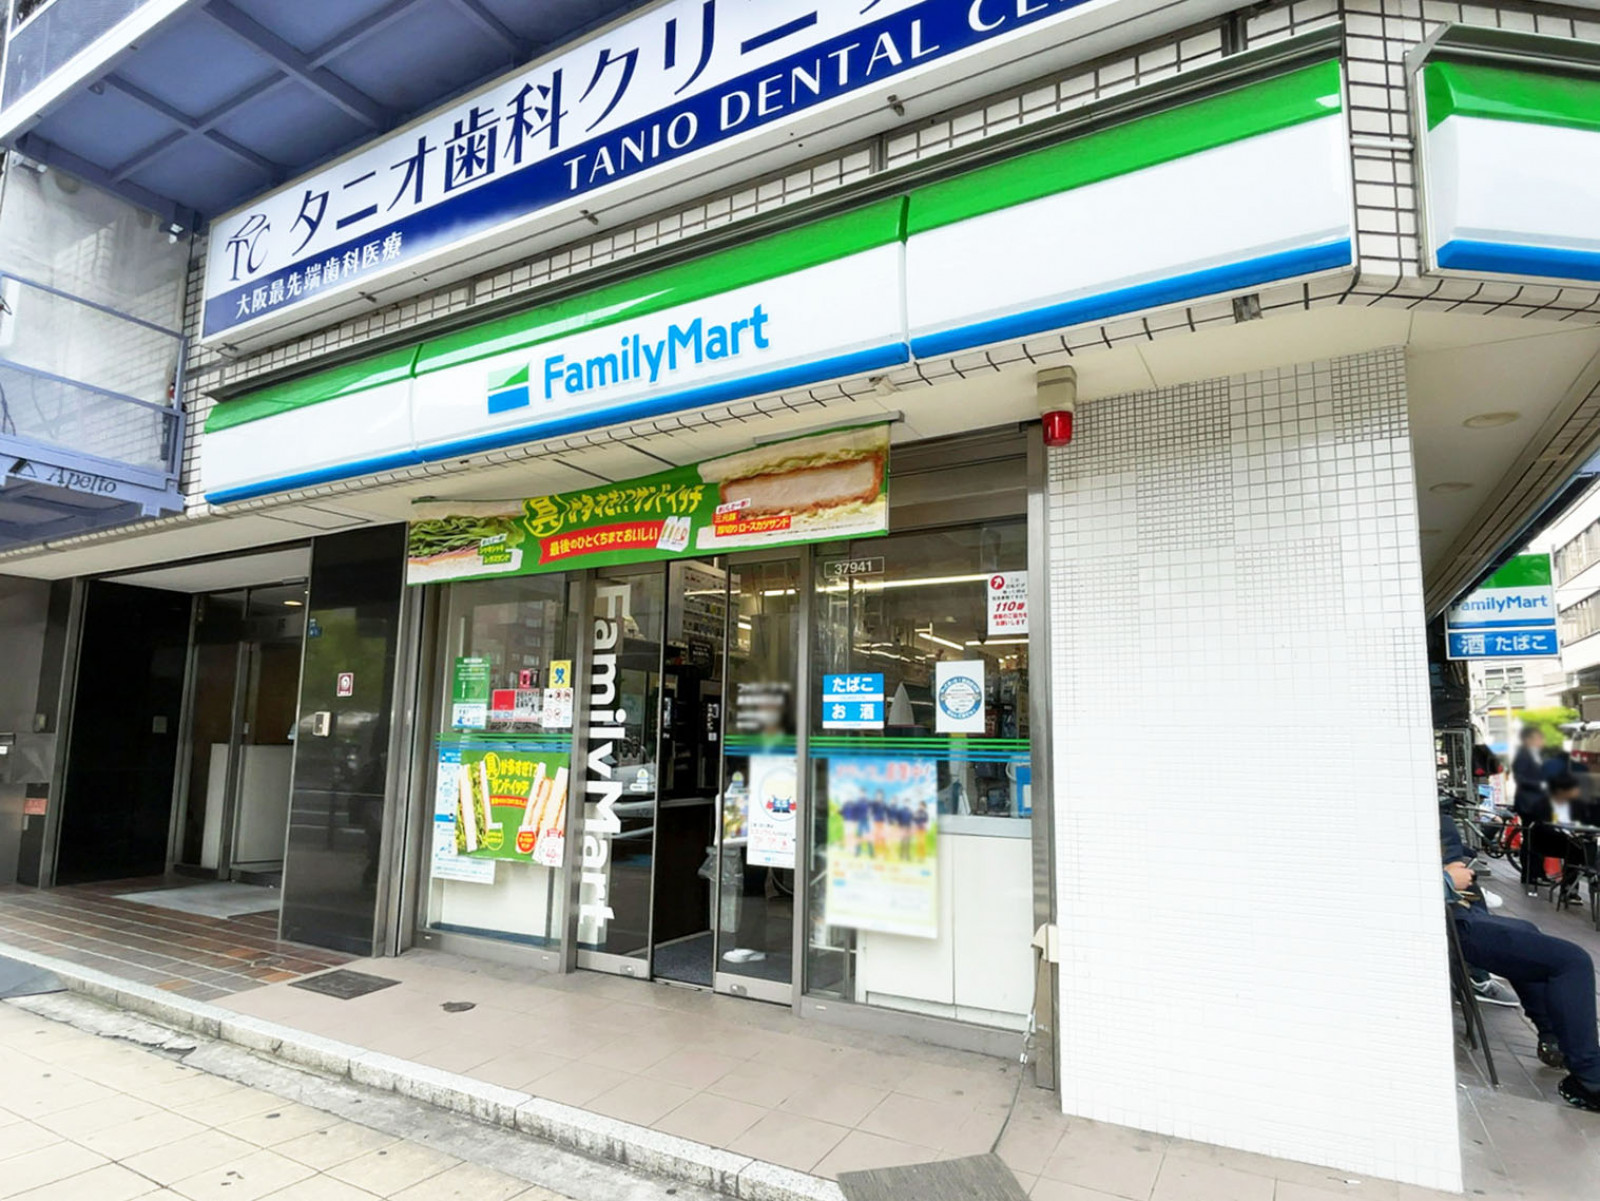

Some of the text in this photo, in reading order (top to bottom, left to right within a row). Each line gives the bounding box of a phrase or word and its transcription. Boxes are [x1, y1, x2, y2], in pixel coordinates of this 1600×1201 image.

[289, 0, 881, 257] タニオ歯科クリ
[563, 111, 698, 191] TANIO
[720, 19, 940, 131] DENTAL
[235, 231, 403, 320] 大阪最先端歯科医療
[544, 303, 769, 400] FamilyMart
[549, 527, 658, 557] 最後のひとくちまでおいしい
[834, 560, 873, 575] 37941
[832, 676, 874, 692] たばこ
[1458, 634, 1548, 655] 酒 たばこ
[578, 583, 631, 930] FamilyMart
